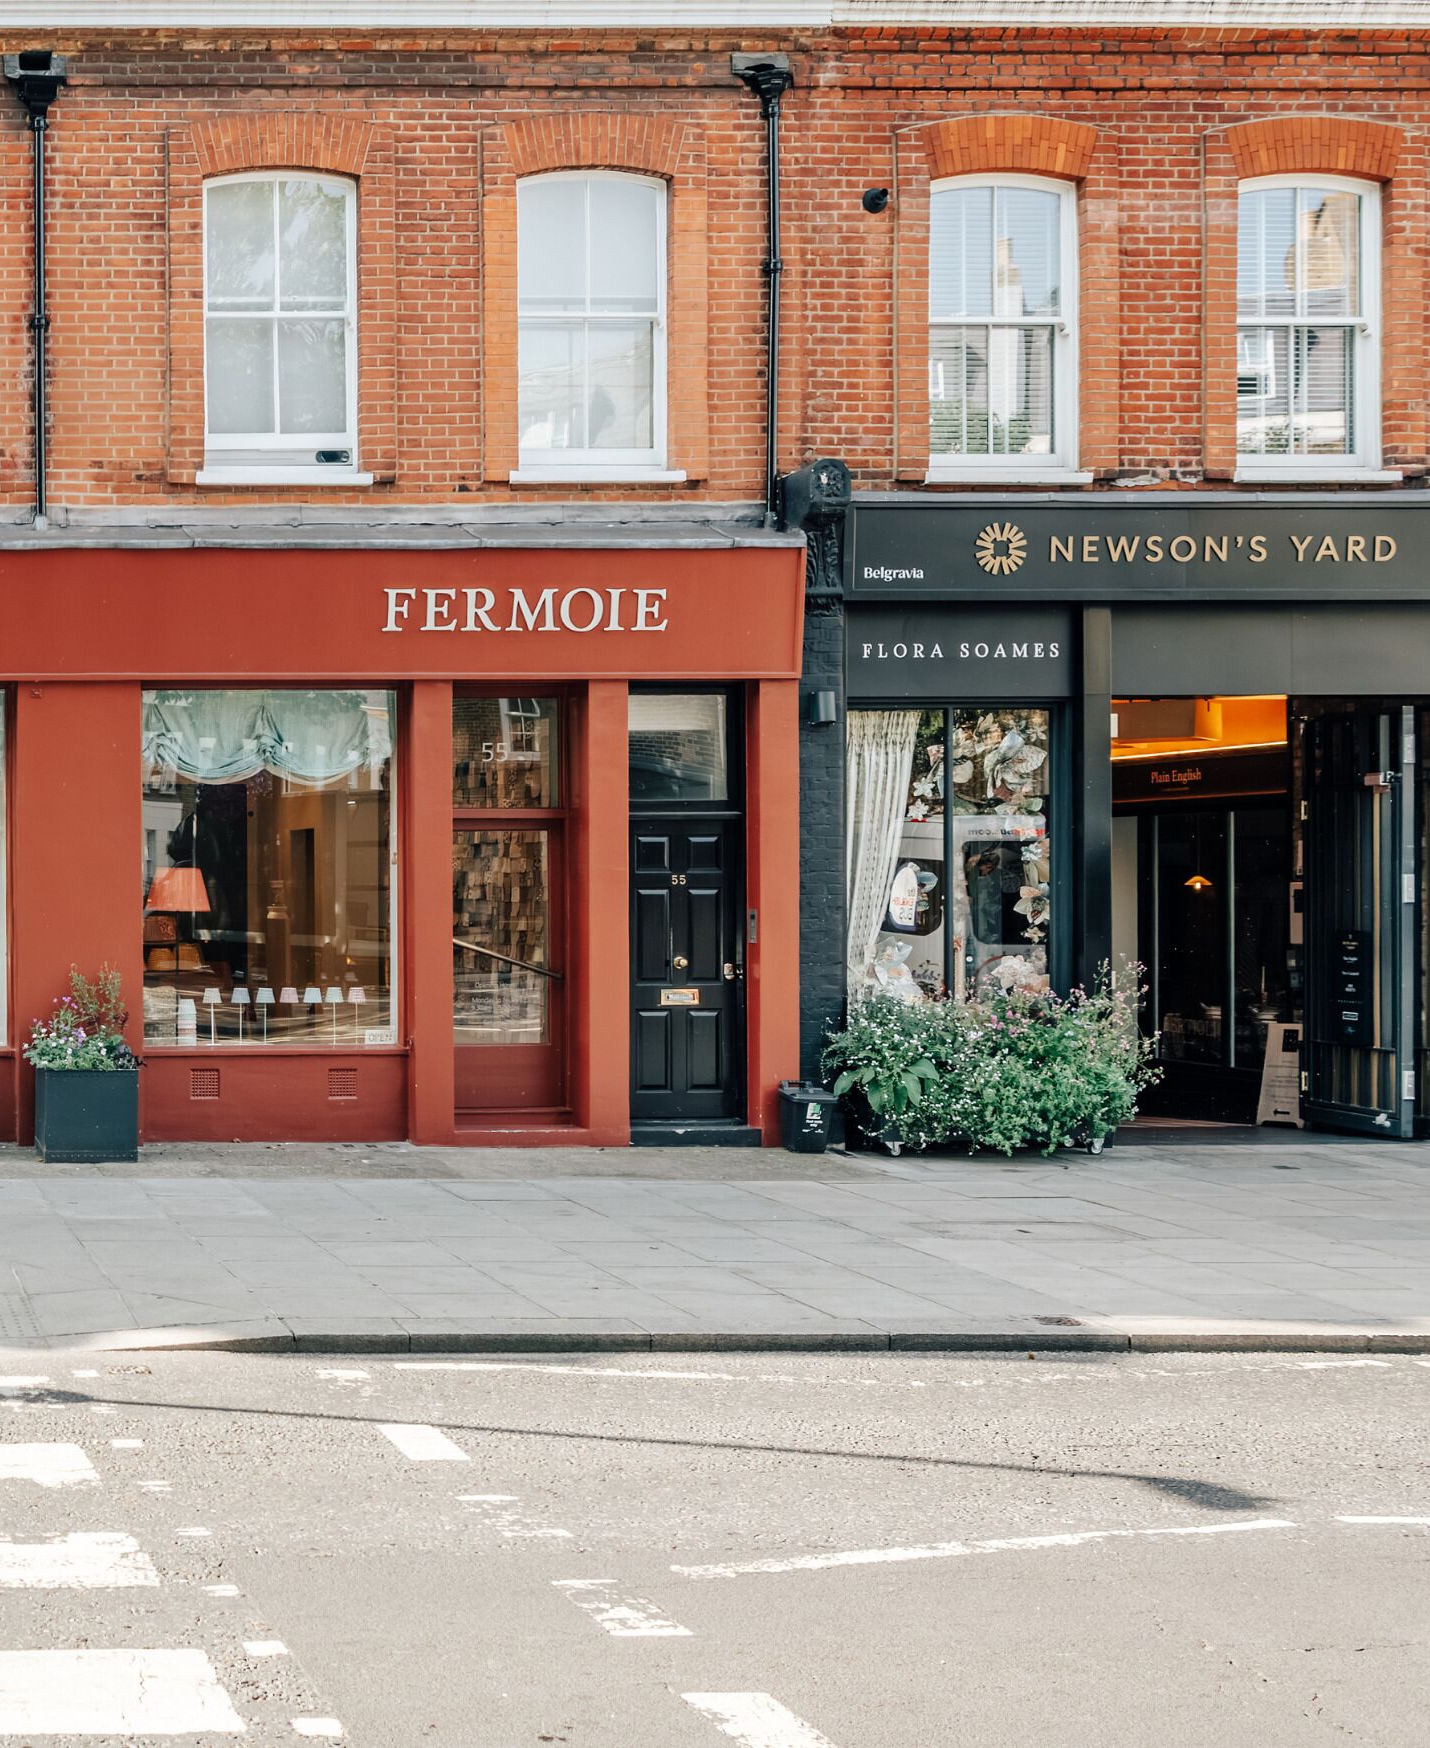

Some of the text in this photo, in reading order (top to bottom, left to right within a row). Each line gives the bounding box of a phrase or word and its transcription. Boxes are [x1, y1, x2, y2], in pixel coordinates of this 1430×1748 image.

[1291, 534, 1398, 562] YARD
[863, 566, 925, 582] Belgravia
[381, 587, 670, 632] FERMOIE
[862, 642, 1061, 659] FLORA SOAMES
[481, 742, 509, 762] 55
[1151, 767, 1202, 784] Plain English
[671, 874, 687, 885] 55
